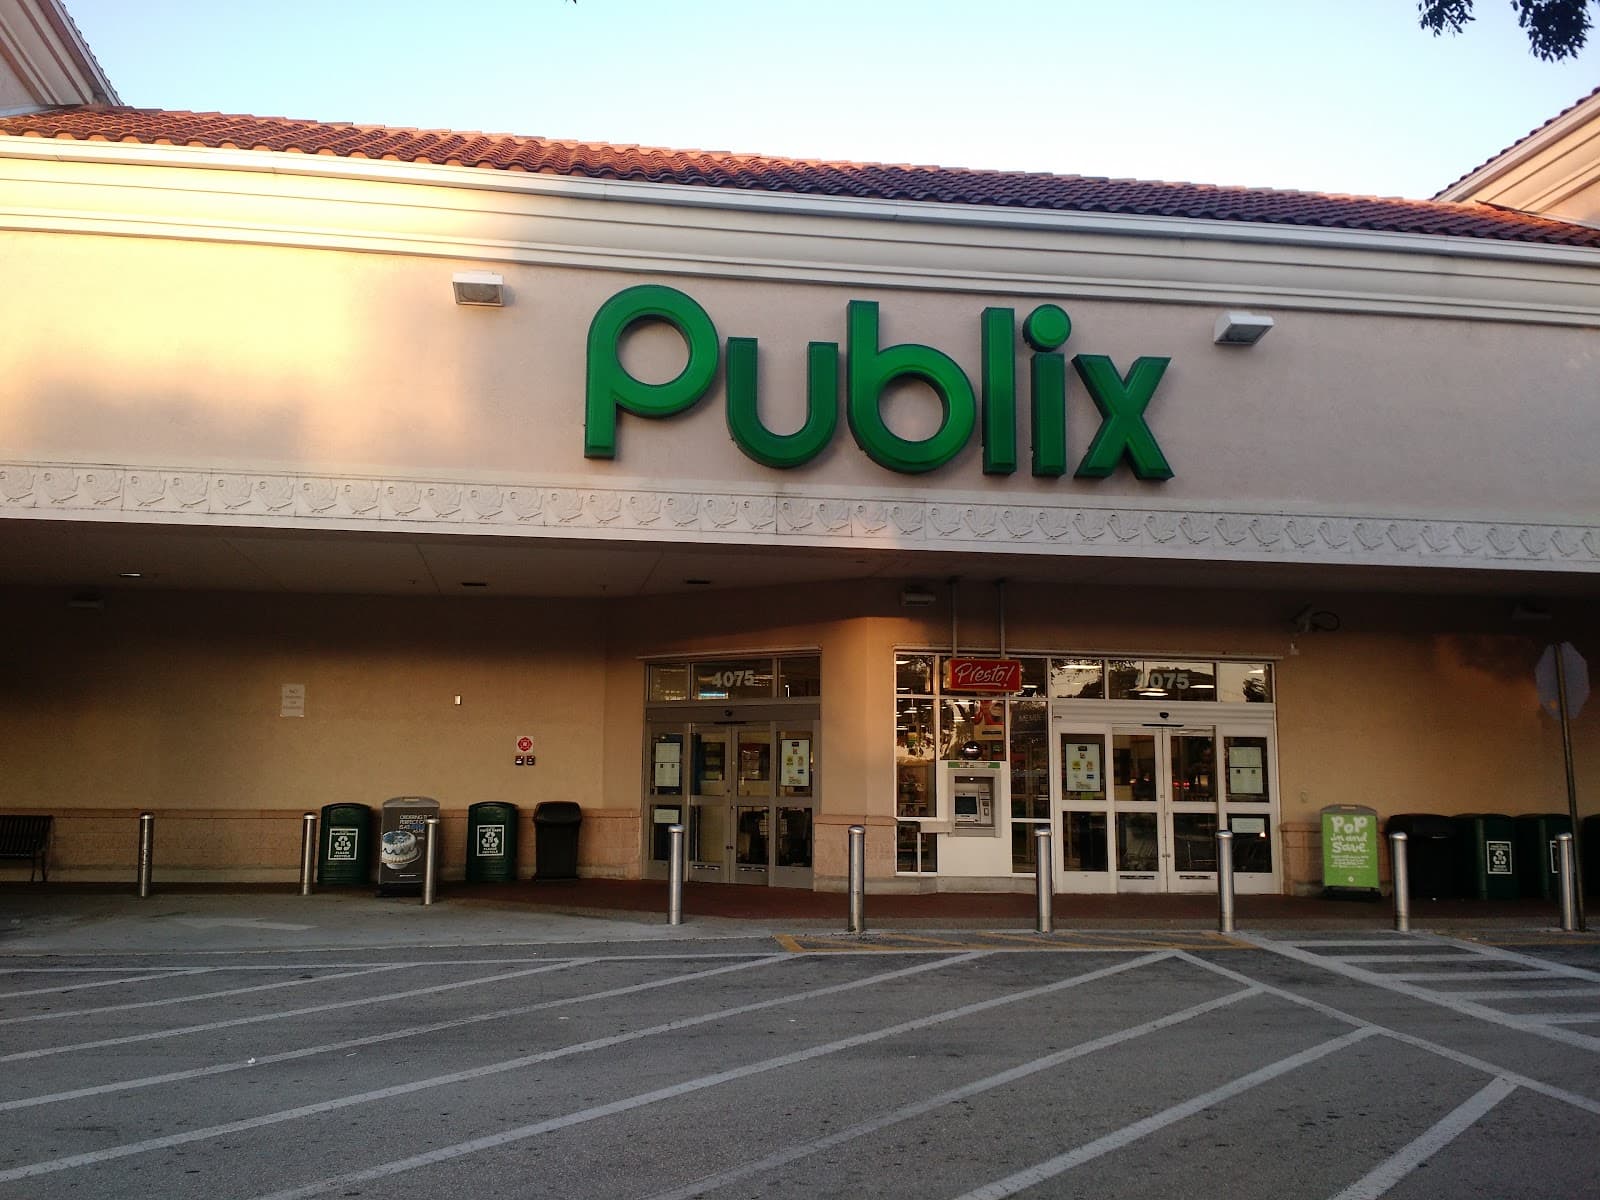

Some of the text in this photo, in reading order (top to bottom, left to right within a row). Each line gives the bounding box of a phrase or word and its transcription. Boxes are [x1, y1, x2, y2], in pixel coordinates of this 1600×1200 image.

[584, 284, 1174, 480] Publix
[711, 669, 754, 688] 4075
[954, 662, 1016, 687] Presto!
[1134, 672, 1190, 690] 4075
